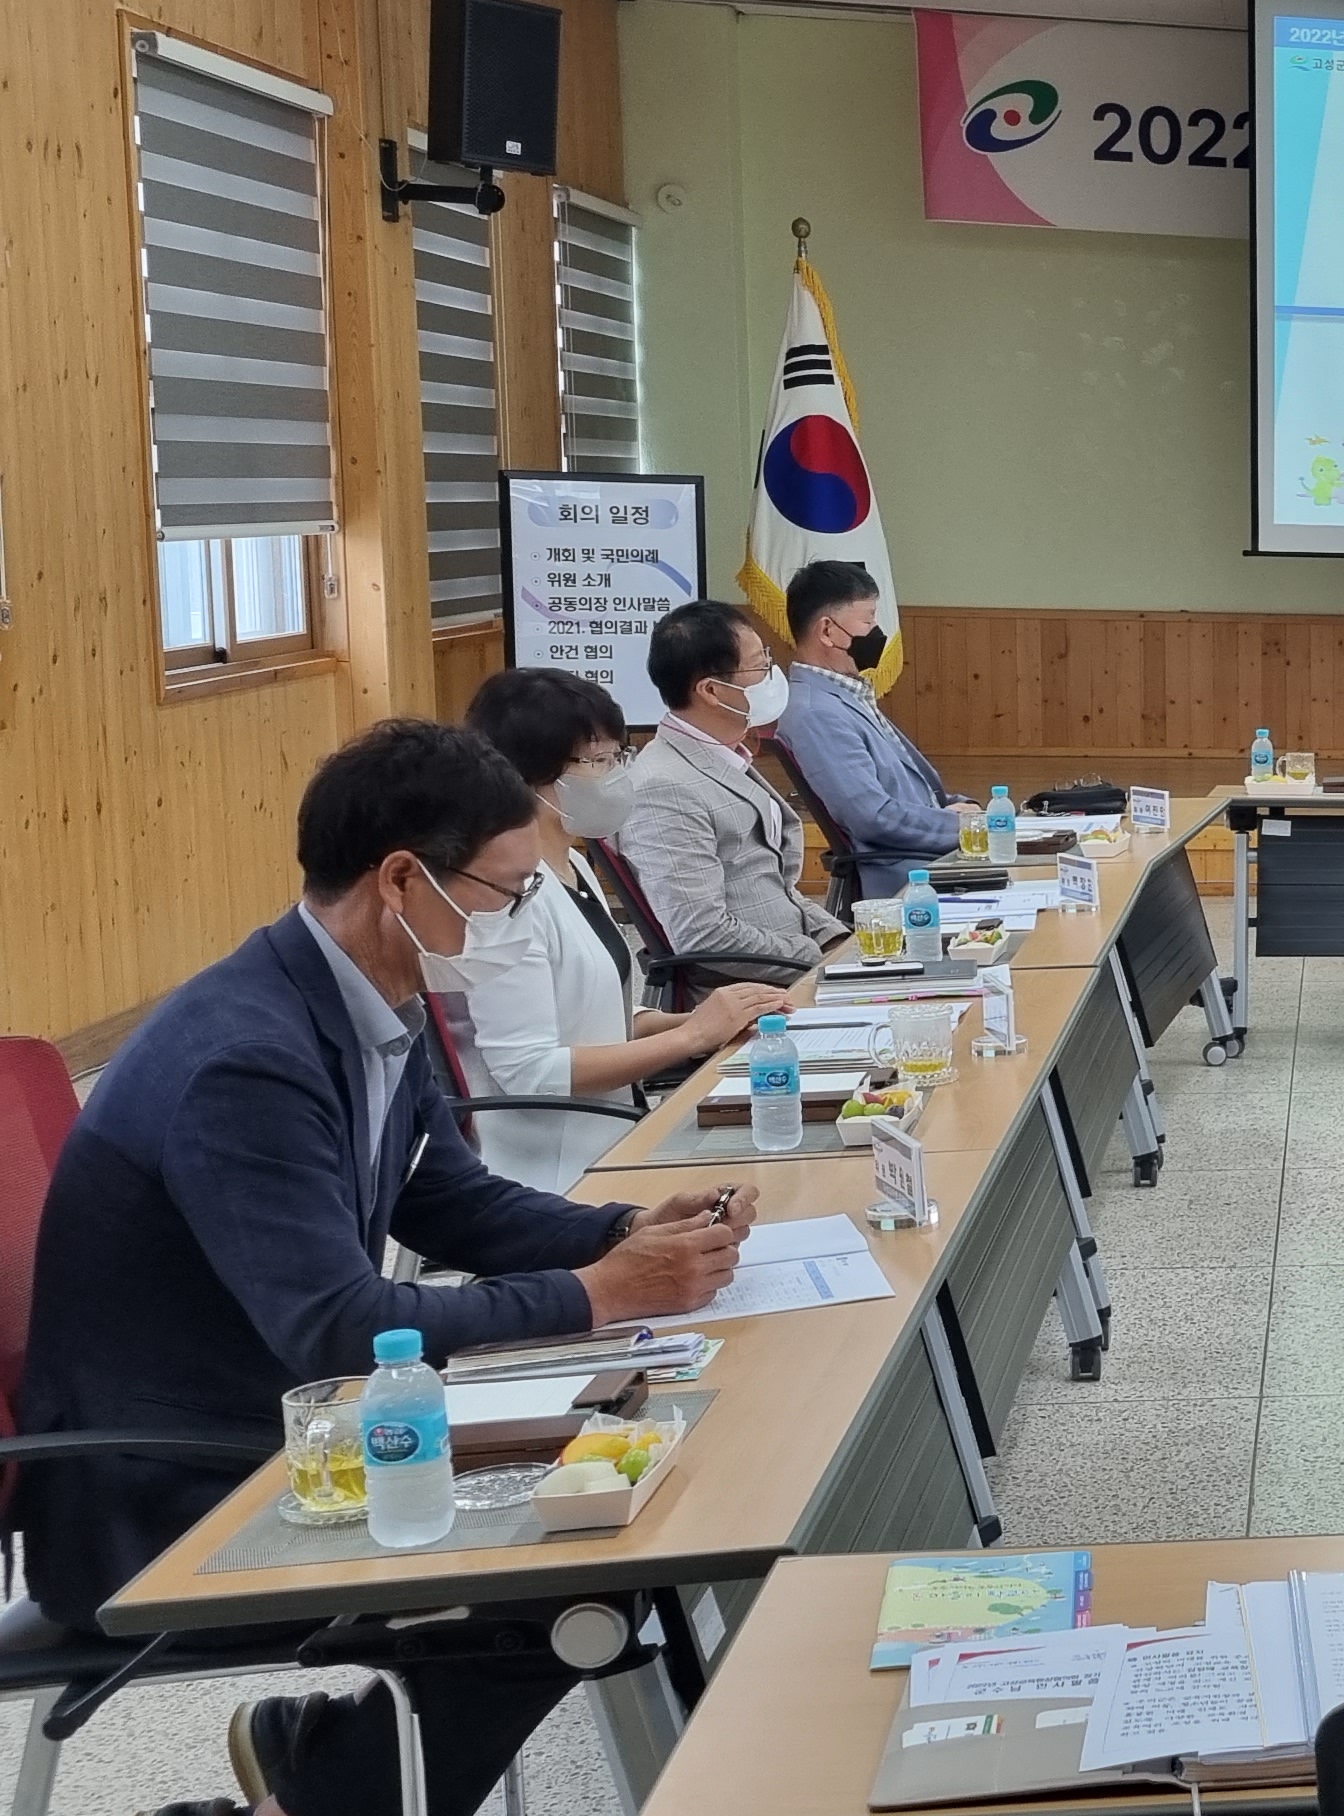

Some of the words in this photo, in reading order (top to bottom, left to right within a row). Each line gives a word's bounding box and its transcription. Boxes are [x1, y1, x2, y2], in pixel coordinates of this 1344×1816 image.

[558, 503, 600, 525] 회의
[608, 504, 650, 526] 일정
[546, 547, 576, 563] 개회
[581, 548, 596, 563] 및
[600, 548, 659, 563] 국민의례
[546, 572, 577, 588] 위원
[582, 572, 612, 588] 소개
[547, 596, 608, 612] 공동의장
[612, 596, 671, 612] 인사말씀
[548, 620, 586, 635] 2021.
[589, 620, 648, 635] 협의결과
[549, 644, 579, 660] 안건
[583, 644, 613, 660] 협의
[370, 1434, 413, 1451] 백산수
